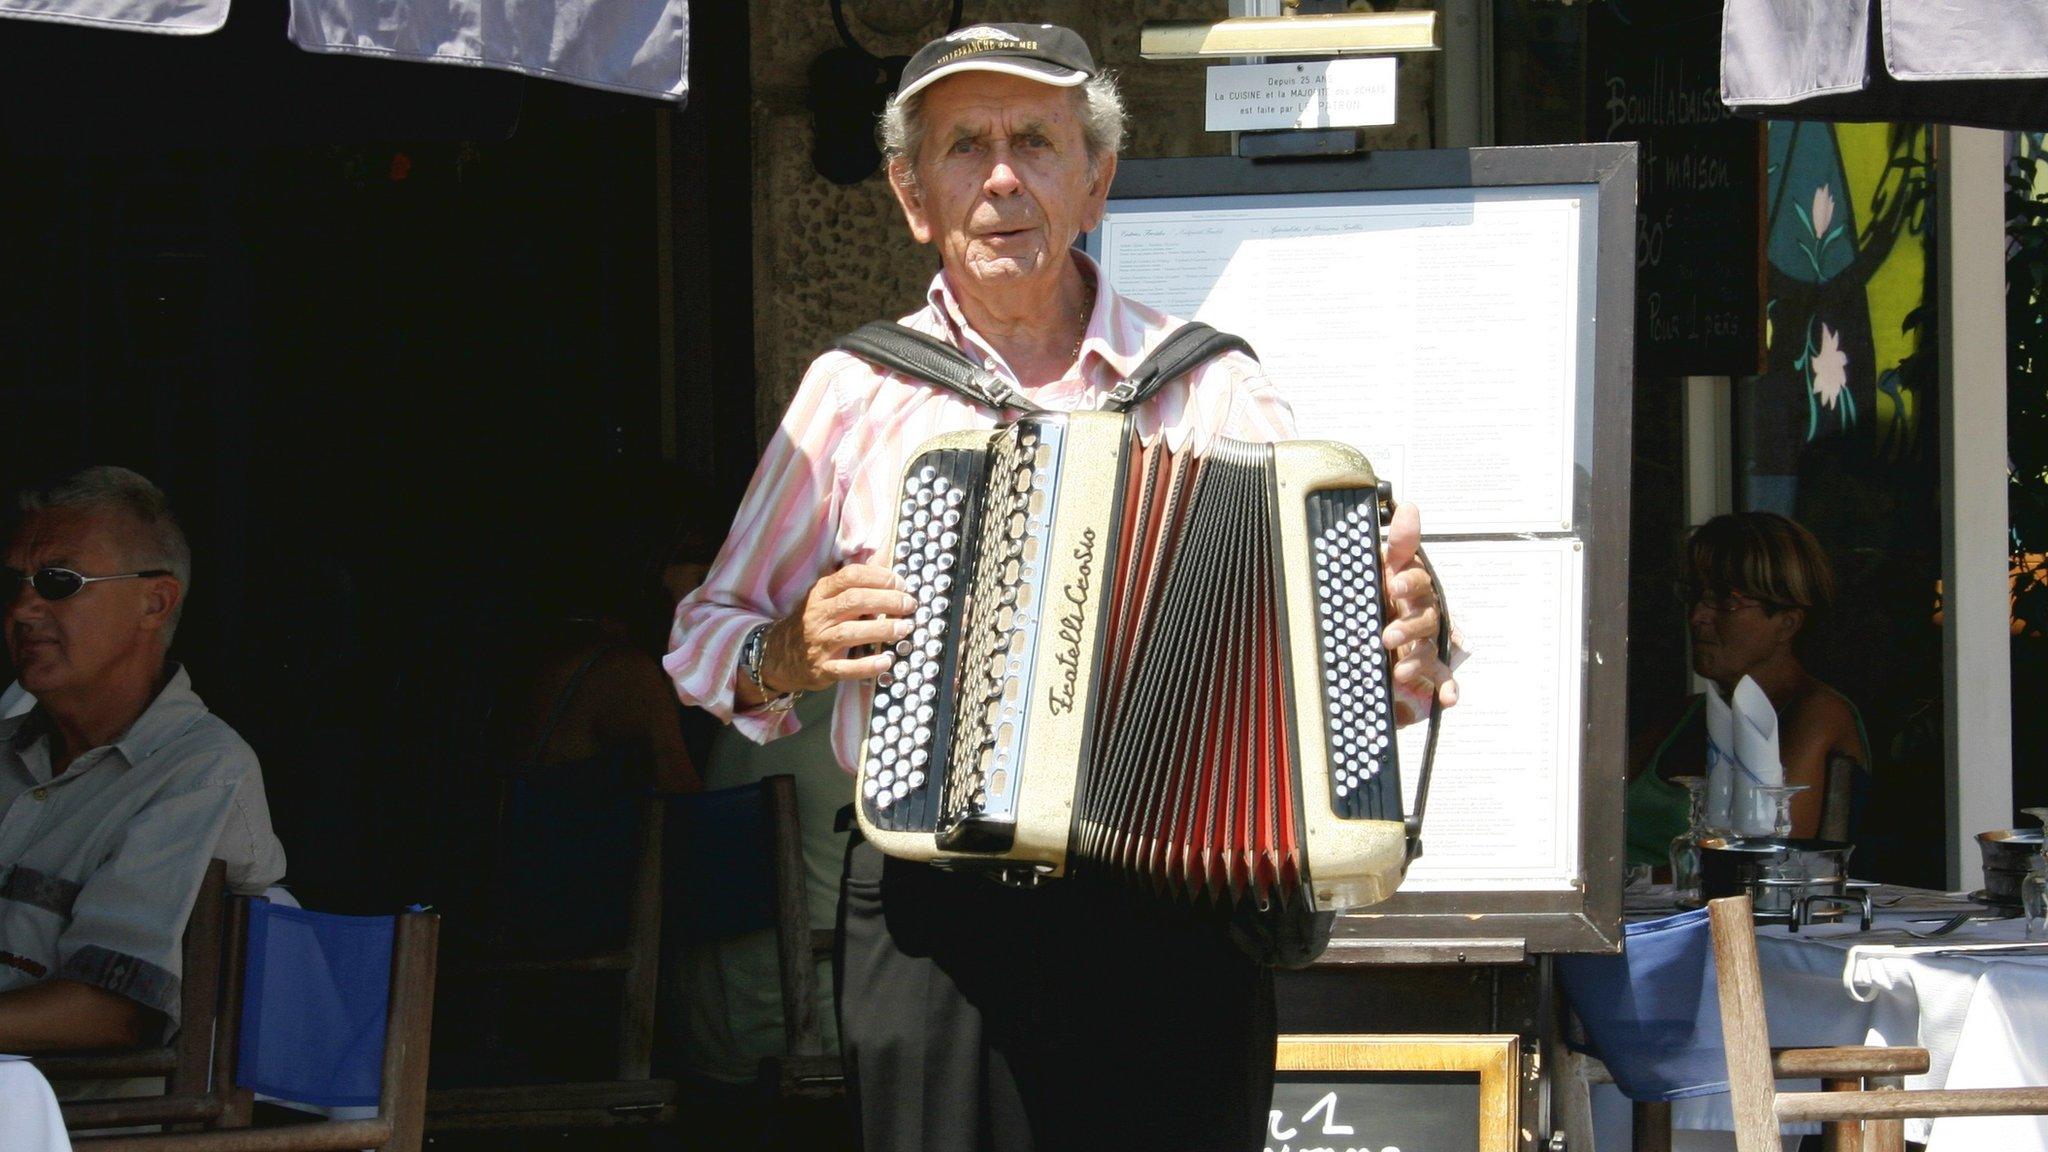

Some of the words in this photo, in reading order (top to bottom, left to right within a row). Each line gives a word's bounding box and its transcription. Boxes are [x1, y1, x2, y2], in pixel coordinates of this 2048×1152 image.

[1019, 40, 1038, 50] MER
[1268, 77, 1296, 86] Depuis
[1300, 76, 1310, 84] 25
[1214, 92, 1224, 101] La
[1229, 90, 1261, 100] CUISINE
[1266, 90, 1274, 99] et
[1278, 89, 1286, 98] la
[1240, 107, 1252, 115] est
[1258, 106, 1275, 114] faite
[1280, 106, 1294, 116] par
